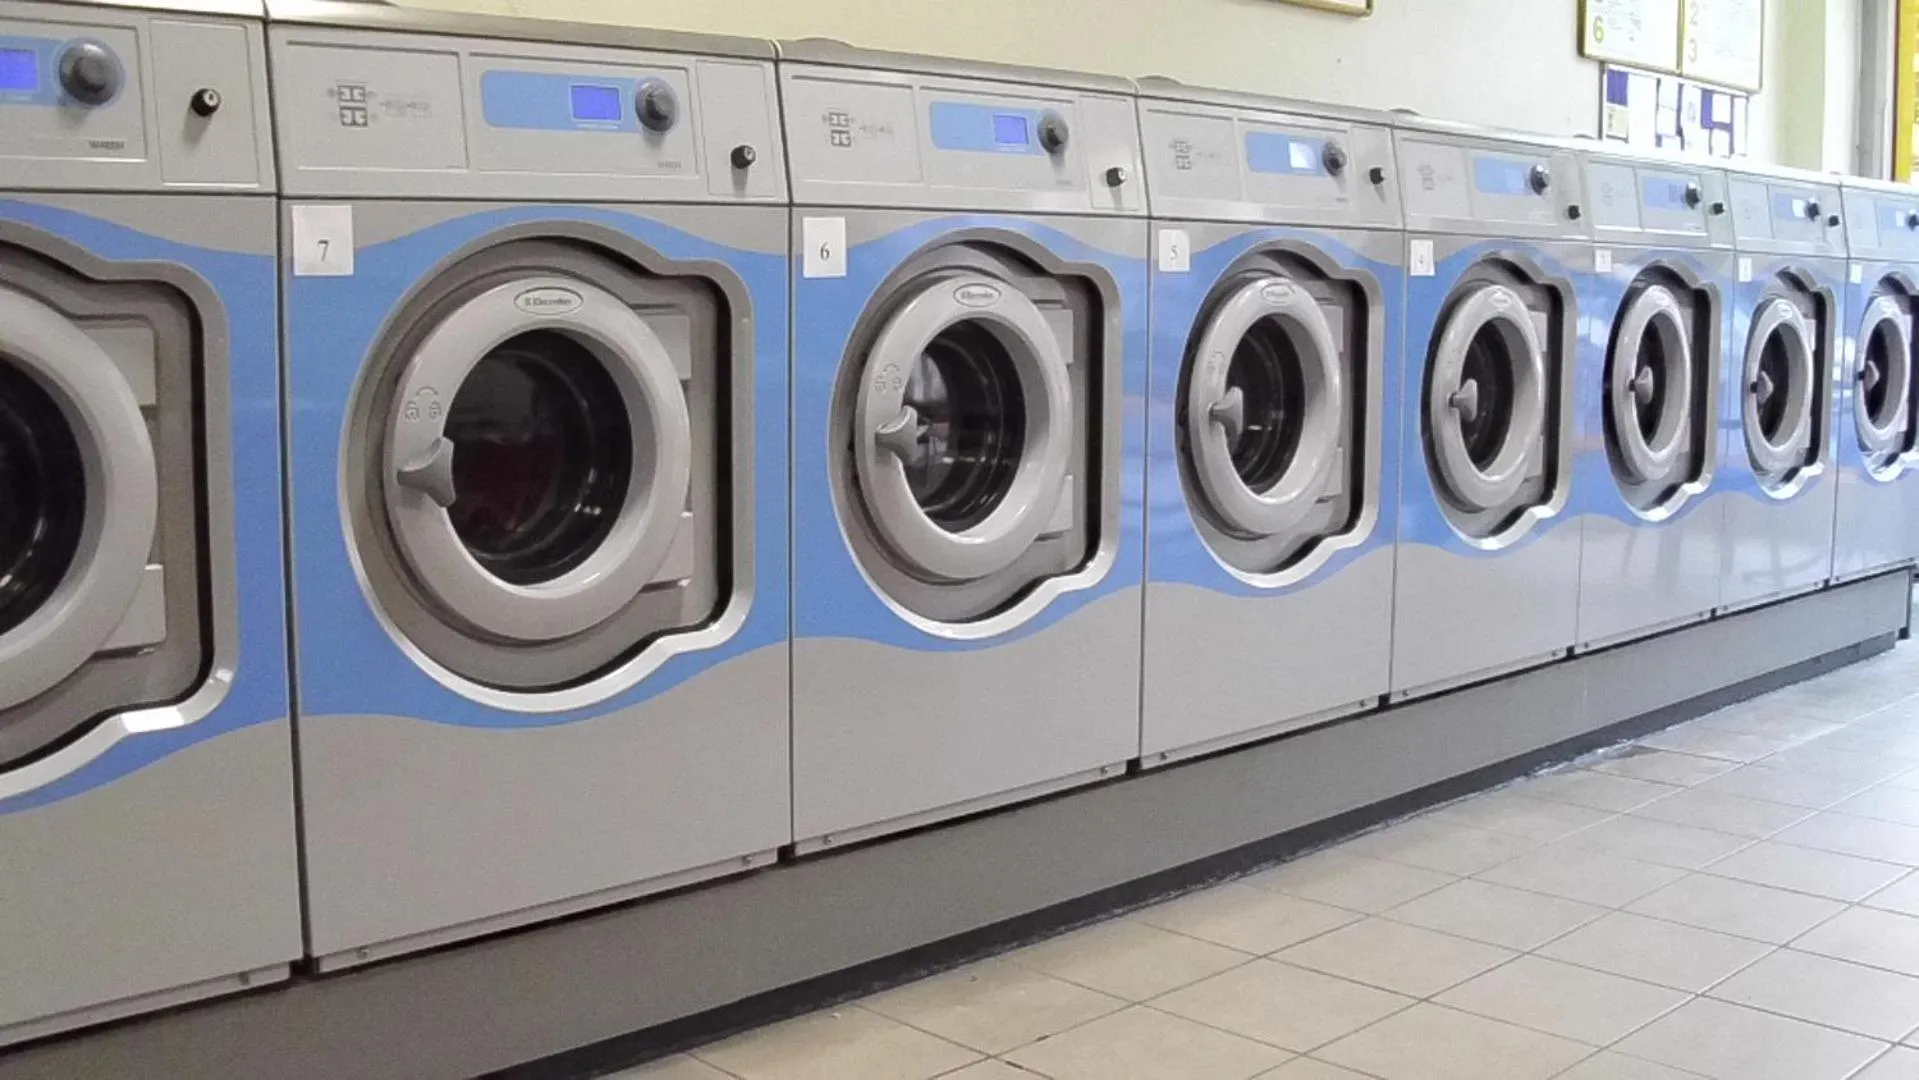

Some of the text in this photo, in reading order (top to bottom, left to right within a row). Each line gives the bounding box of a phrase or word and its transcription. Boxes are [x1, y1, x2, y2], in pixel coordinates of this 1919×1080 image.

[1593, 15, 1605, 43] 6
[1688, 38, 1697, 62] 3
[317, 239, 330, 262] 7
[819, 241, 831, 260] 6
[1170, 244, 1179, 260] 5
